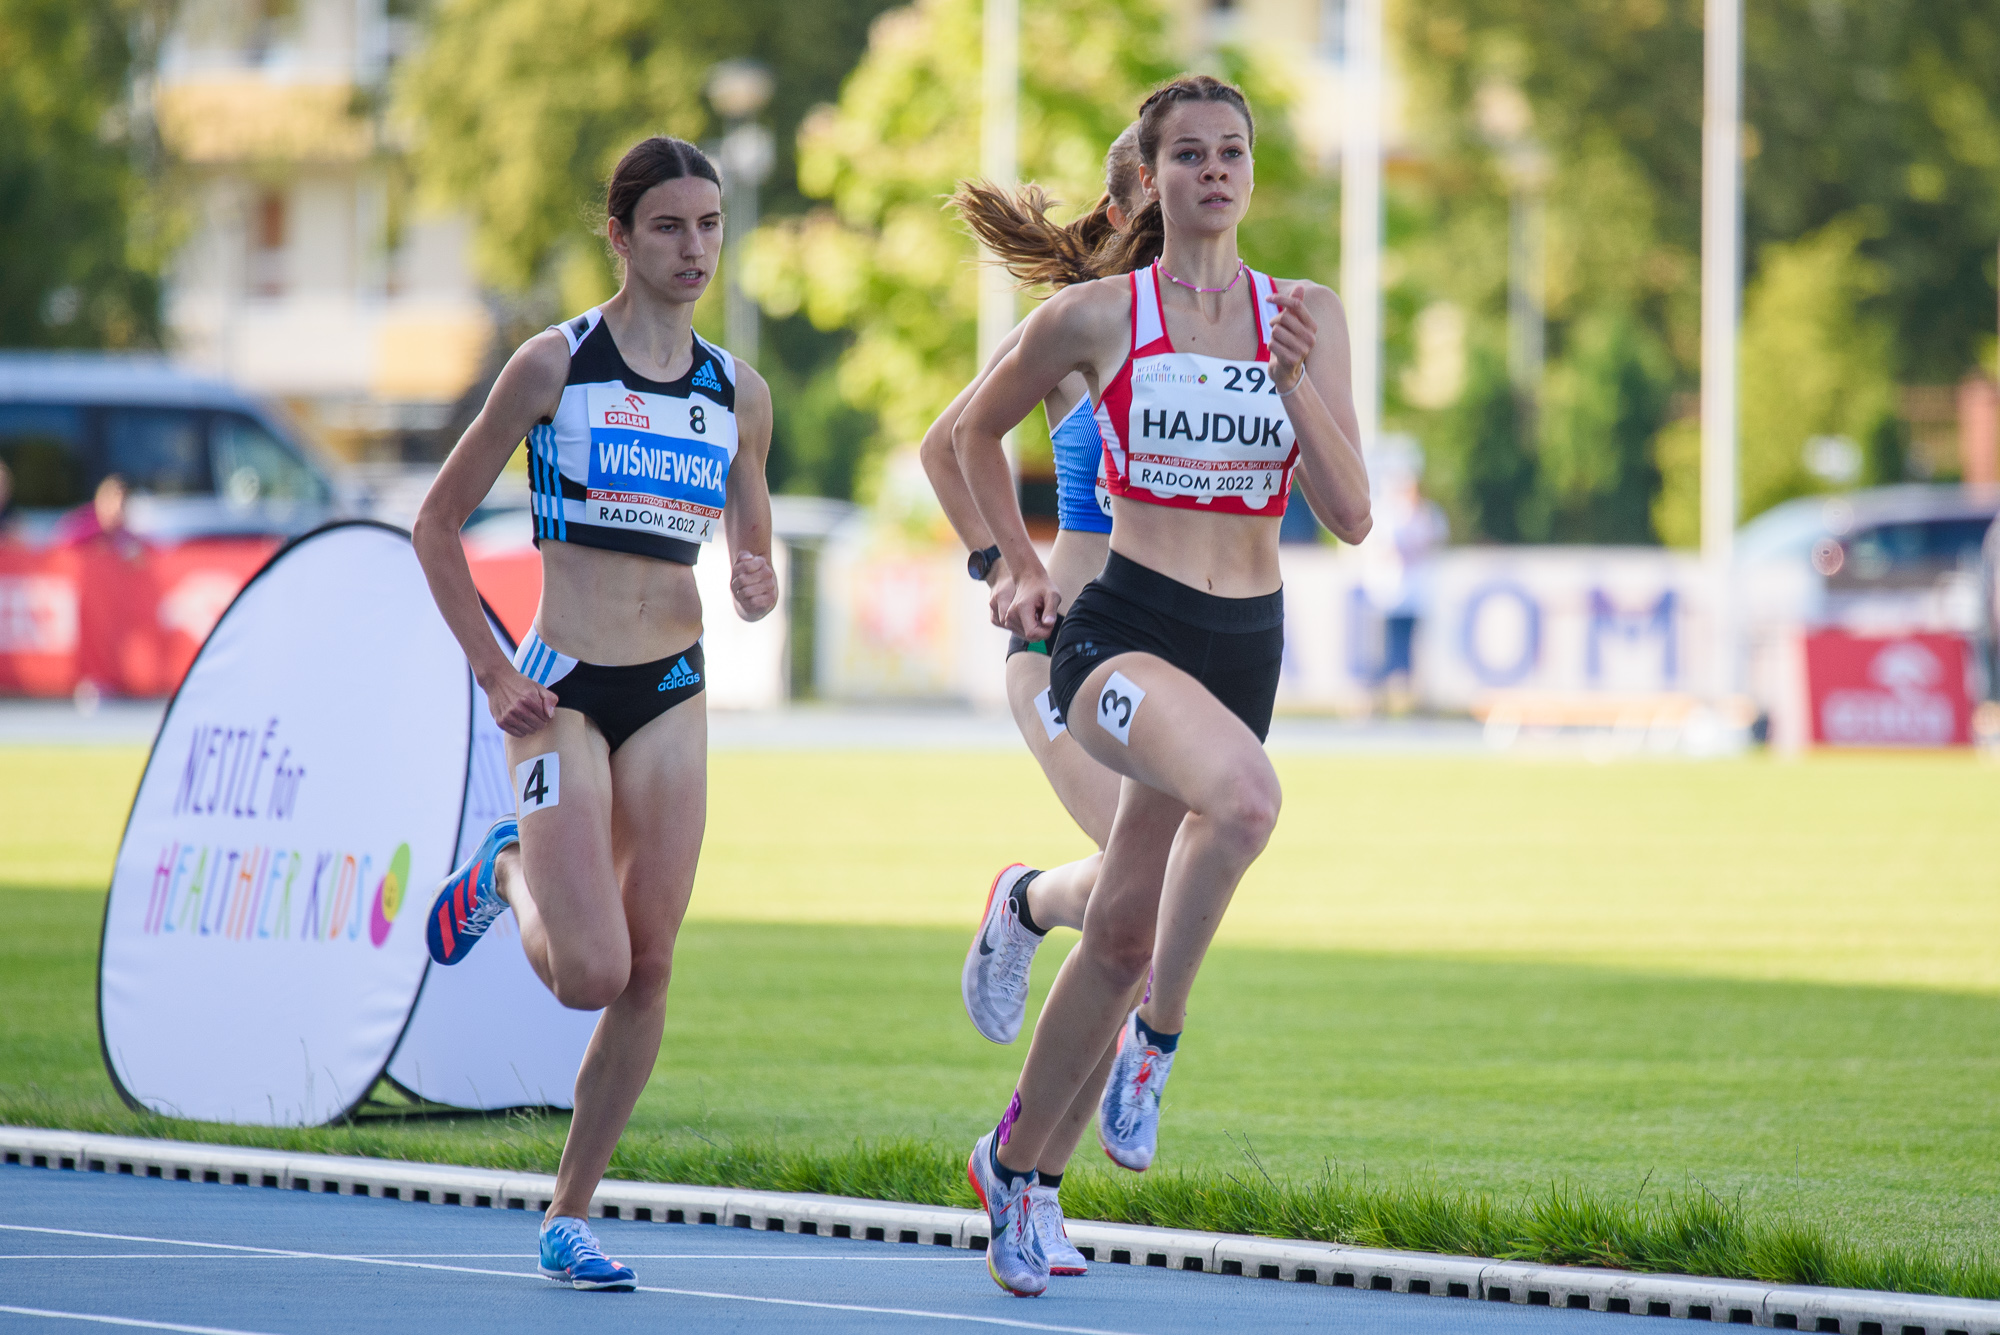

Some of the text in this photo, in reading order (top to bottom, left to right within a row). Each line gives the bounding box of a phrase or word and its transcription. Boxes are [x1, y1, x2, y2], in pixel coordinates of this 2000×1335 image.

[691, 376, 722, 392] adidas
[1222, 365, 1278, 395] 29
[607, 412, 648, 428] ORLEN
[689, 405, 706, 435] 8
[1142, 408, 1284, 447] HAJDUK
[598, 439, 723, 492] WIŚNIEWSKA
[1133, 453, 1160, 463] PZLA
[1161, 455, 1229, 471] MISTRZOSTWA
[1230, 461, 1261, 471] POLSKI
[1141, 468, 1254, 491] RADOM 2022
[591, 490, 618, 501] PZLA
[619, 493, 681, 510] MISTRZOSTWA
[681, 502, 705, 515] POLSKI
[600, 506, 695, 534] RADOM 2022
[657, 671, 701, 692] adidas
[1101, 688, 1132, 729] 3
[173, 716, 306, 821] NESTLÉ for
[523, 758, 549, 806] 4
[143, 840, 373, 943] HEALTHIER KIDS
